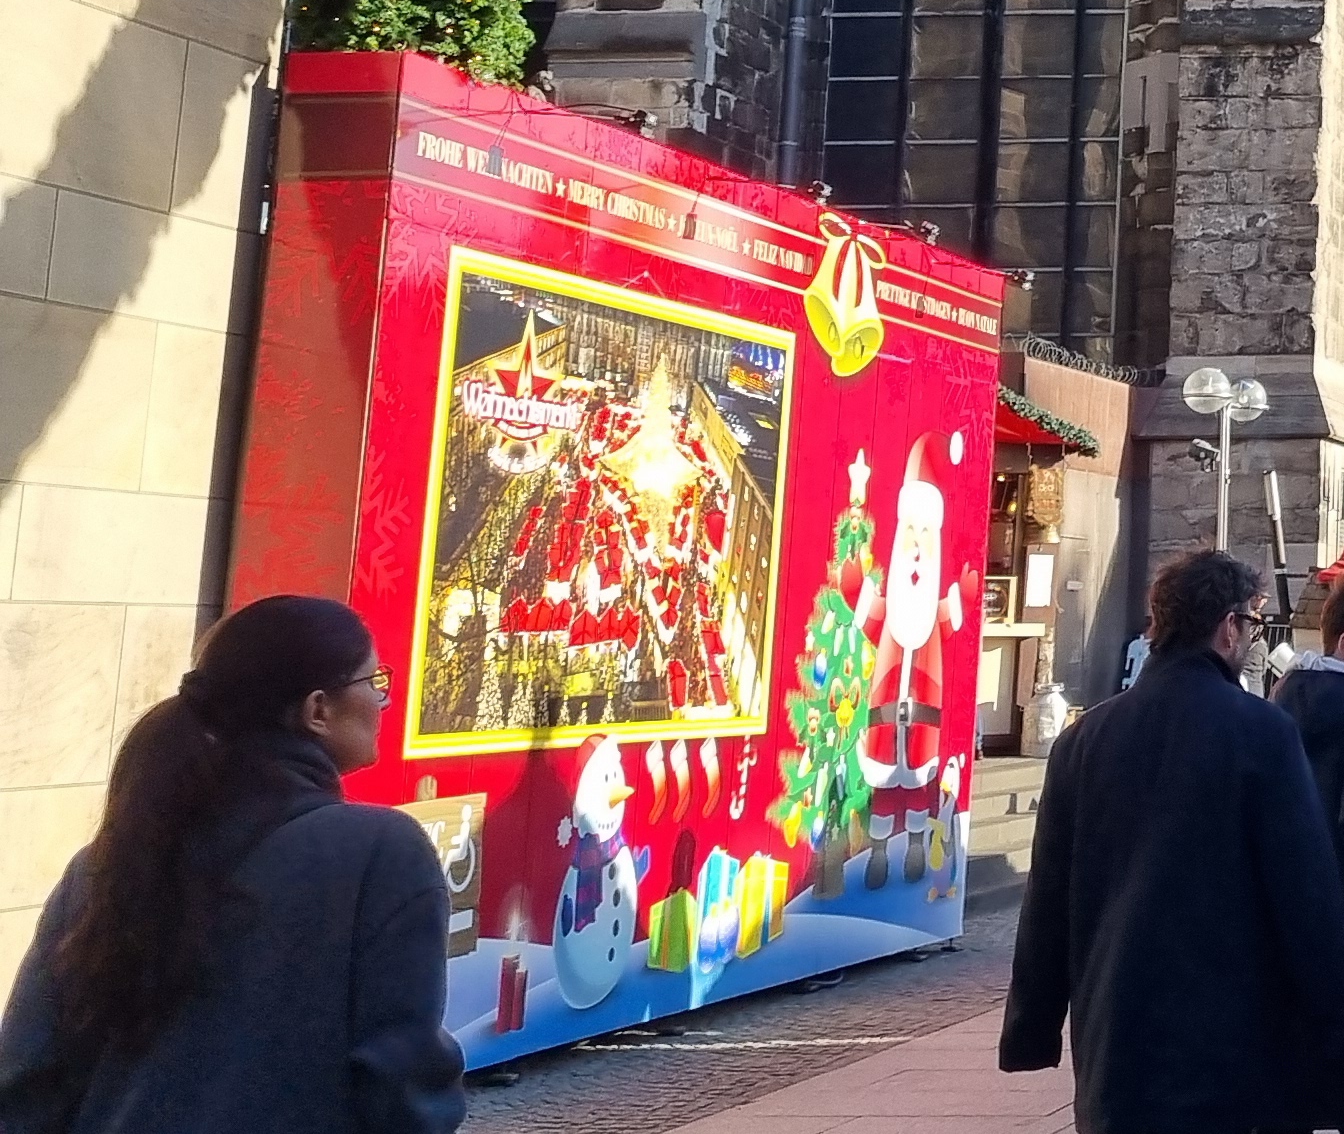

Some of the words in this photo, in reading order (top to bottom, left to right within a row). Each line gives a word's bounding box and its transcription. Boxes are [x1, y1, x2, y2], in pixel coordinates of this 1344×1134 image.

[417, 131, 465, 168] FROHE
[466, 146, 555, 195] WENACHTEN
[568, 178, 607, 211] MERRY
[607, 191, 667, 230] CHRISTMAS
[677, 213, 739, 253] JEUX-NOËL
[753, 238, 779, 266] FELIZ
[779, 247, 814, 277] NAVIDAD
[876, 279, 911, 308] PRETTIGE
[911, 291, 952, 322] KSTDAGEN
[957, 307, 976, 329] BUON
[975, 313, 998, 336] NATALE
